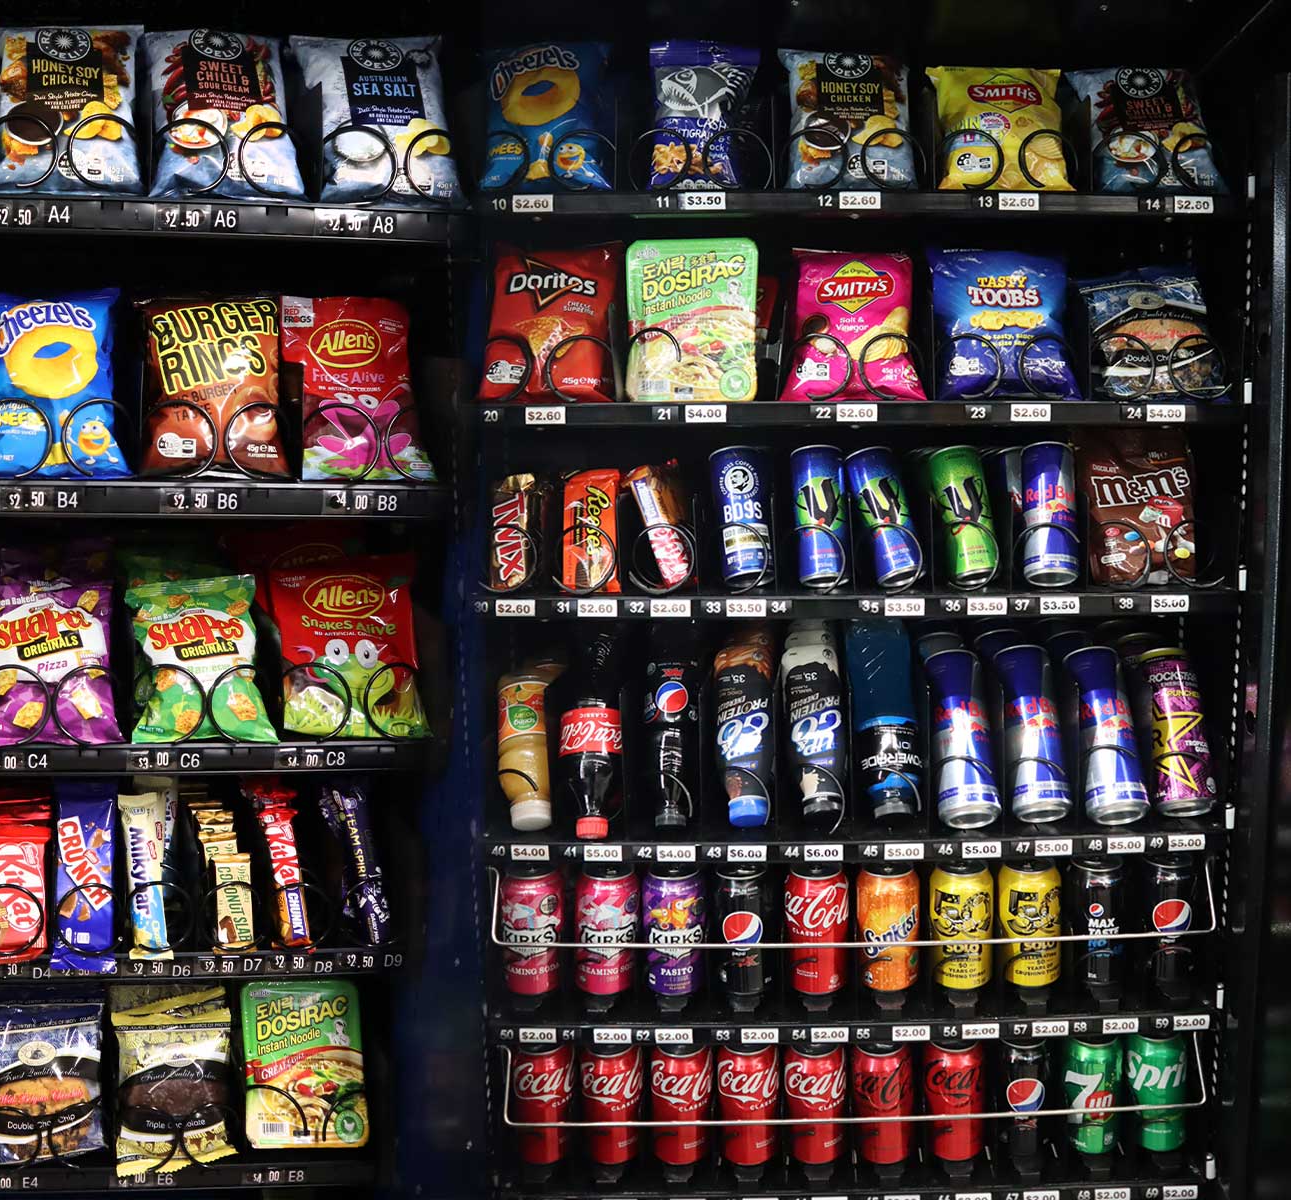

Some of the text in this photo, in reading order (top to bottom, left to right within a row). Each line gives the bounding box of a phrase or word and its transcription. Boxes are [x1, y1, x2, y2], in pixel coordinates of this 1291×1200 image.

[32, 58, 100, 78] HONEY SOY
[199, 61, 243, 74] SWEET
[491, 45, 579, 100] Cheezels
[42, 73, 89, 86] CHICKEN
[196, 72, 236, 84] CHILLI
[358, 75, 408, 83] AUSTRALIAN
[198, 81, 250, 93] SOUR CREAM
[352, 82, 417, 98] SEA SALT
[821, 82, 880, 95] HONEY SOY
[972, 87, 1037, 102] SMITH'S
[830, 95, 872, 103] CHICKEN
[656, 196, 722, 208] 11 $3.50
[979, 197, 1035, 207] 13 $2.60
[48, 205, 70, 223] A4
[372, 216, 394, 234] A8
[643, 257, 685, 278] 도시락
[509, 272, 598, 296] Doritos
[643, 256, 746, 301] DOSIRAC
[977, 275, 1027, 288] TASTY
[821, 279, 888, 296] SMITH'S
[642, 288, 711, 316] Instant Noodle
[968, 286, 1040, 307] TOOBS
[152, 300, 278, 348] BURGER
[284, 315, 311, 323] FROGS
[316, 329, 375, 356] Allen's
[160, 336, 267, 394] RINGS
[350, 370, 385, 383] Alive
[484, 411, 561, 422] 20 $2.60
[1127, 408, 1182, 418] 24 $4.00
[217, 493, 238, 509] B6
[723, 502, 763, 522] BOSS
[493, 494, 524, 581] TWIX
[316, 587, 379, 608] Allen's
[1119, 598, 1185, 608] 38 $5.00
[706, 602, 763, 613] 33 $3.50
[181, 641, 235, 657] ORIGINALS
[37, 658, 68, 673] Pizza
[28, 754, 48, 769] C4
[326, 751, 345, 766] C8
[492, 846, 545, 858] 40 $4.00
[938, 844, 997, 855] 46 $5.00
[59, 820, 111, 906] CRUNCH
[287, 892, 304, 936] CHUNKY
[1088, 918, 1116, 927] MAX
[793, 927, 823, 937] CLASSIC
[243, 959, 263, 971] D7
[661, 966, 694, 976] PASITO
[256, 998, 347, 1039] DOSIRAC
[1155, 1018, 1206, 1028] 59 $2.00
[257, 1028, 321, 1056] Instant Noodle
[637, 1030, 689, 1041] 52 $2.00
[288, 1170, 304, 1182] E8
